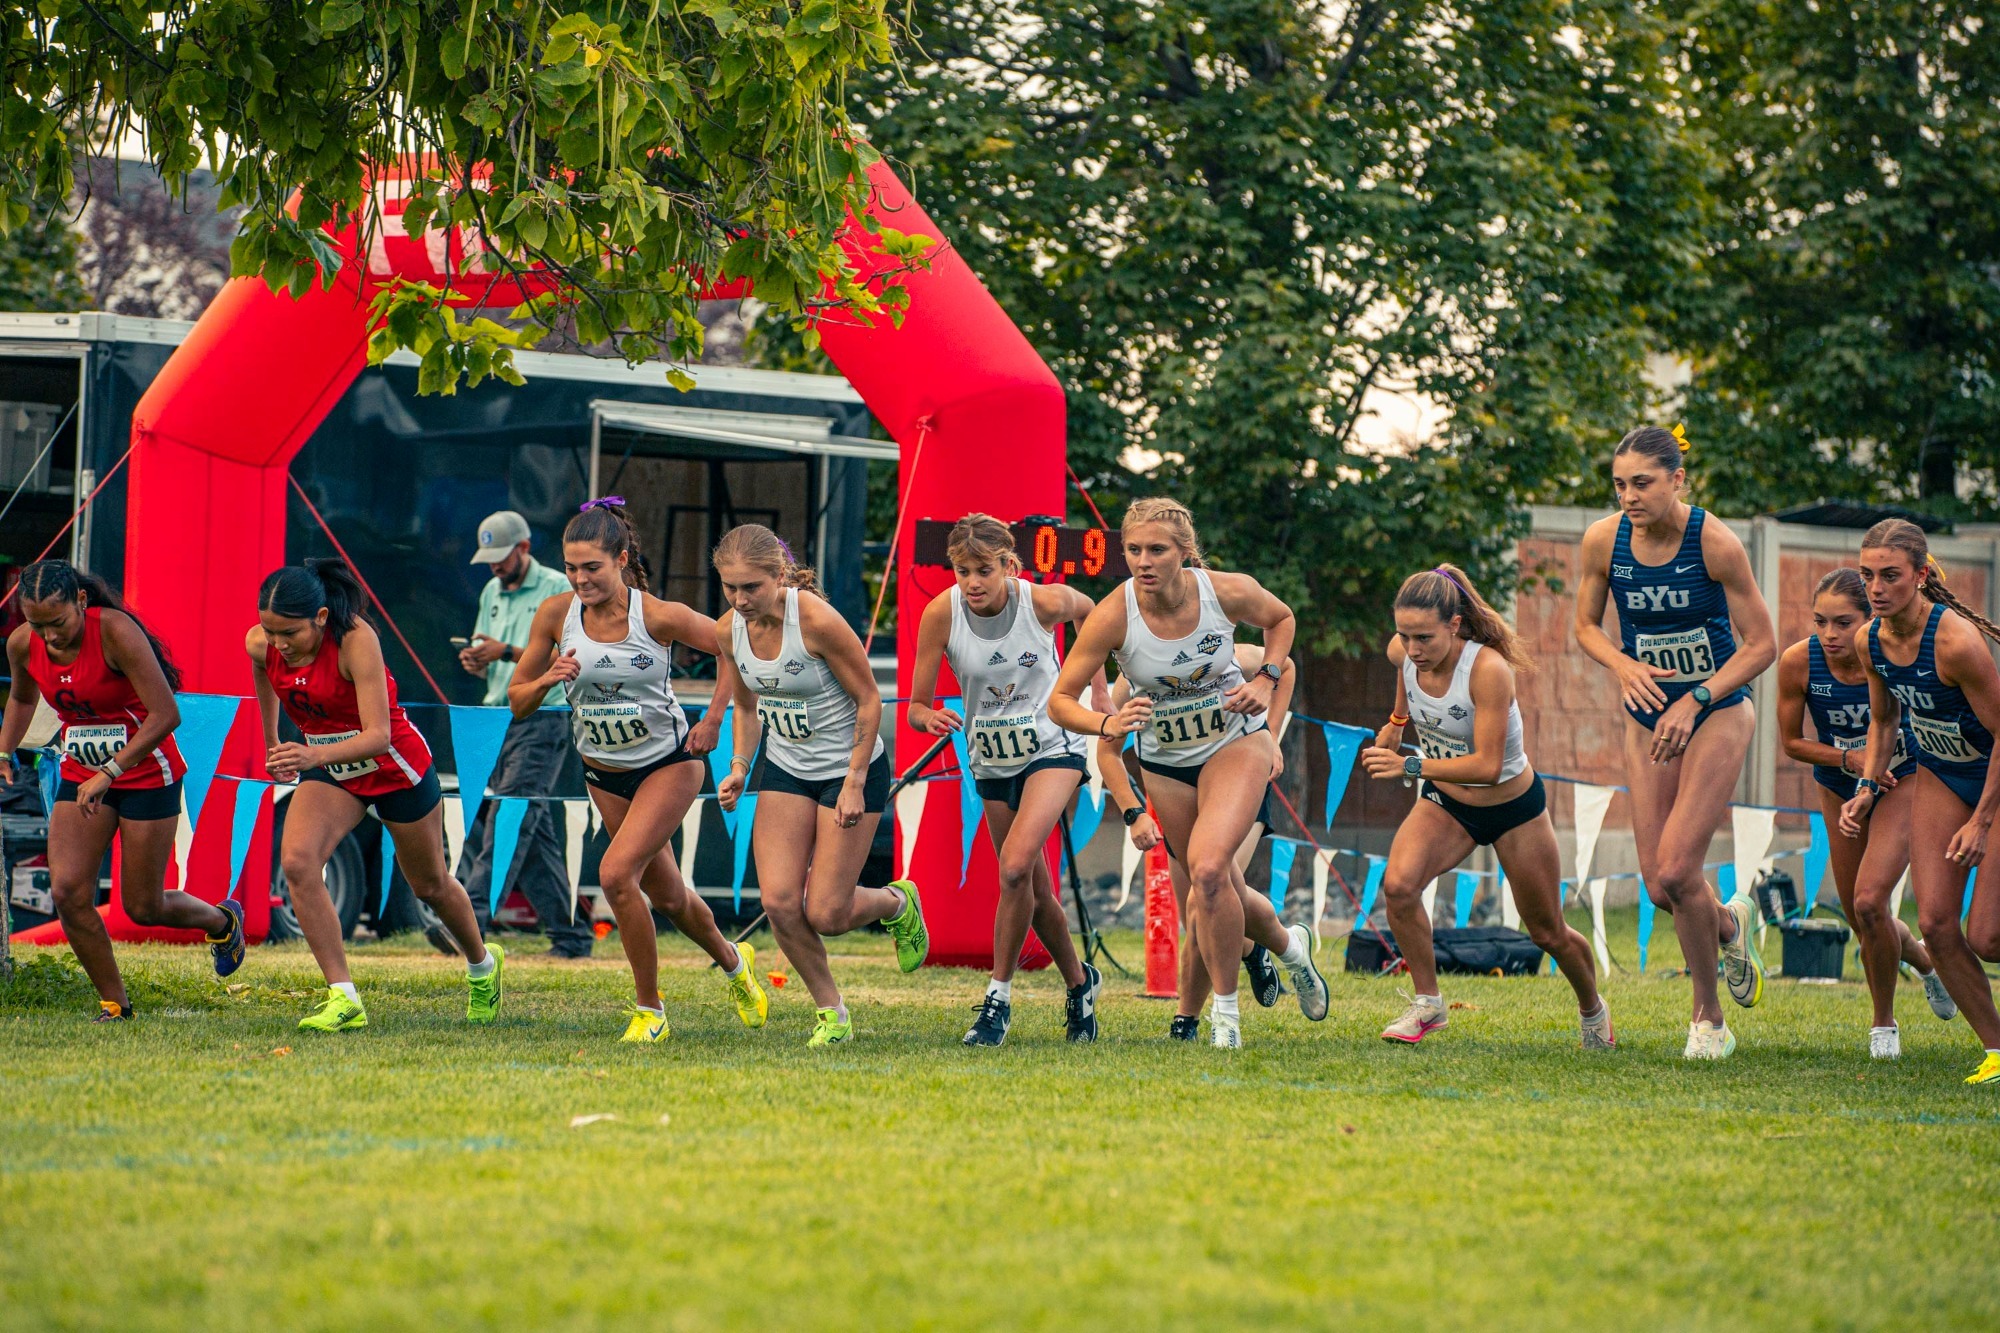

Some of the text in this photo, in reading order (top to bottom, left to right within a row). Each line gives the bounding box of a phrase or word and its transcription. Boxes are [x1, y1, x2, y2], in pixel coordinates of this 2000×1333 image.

[1034, 526, 1107, 576] 0.9
[1625, 585, 1690, 611] BYU
[1198, 637, 1222, 652] RMAC
[1640, 629, 1706, 647] BYU AUTUMN CLASSIC
[1171, 657, 1193, 667] adidas
[581, 706, 639, 717] BYU AUTUMN CLASSIC
[783, 700, 805, 710] CLASSIC
[1155, 695, 1219, 718] BYU AUTUMN CLASSIC
[758, 708, 812, 739] 3115
[975, 715, 1034, 728] BYU AUTUMN CLASSIC
[1156, 708, 1226, 743] 3114
[69, 727, 125, 738] BYU AUTUMN CLASSIC
[583, 718, 649, 746] 3118
[1913, 726, 1972, 757] 3007
[976, 728, 1041, 759] 3113
[1849, 738, 1867, 749] AUTU
